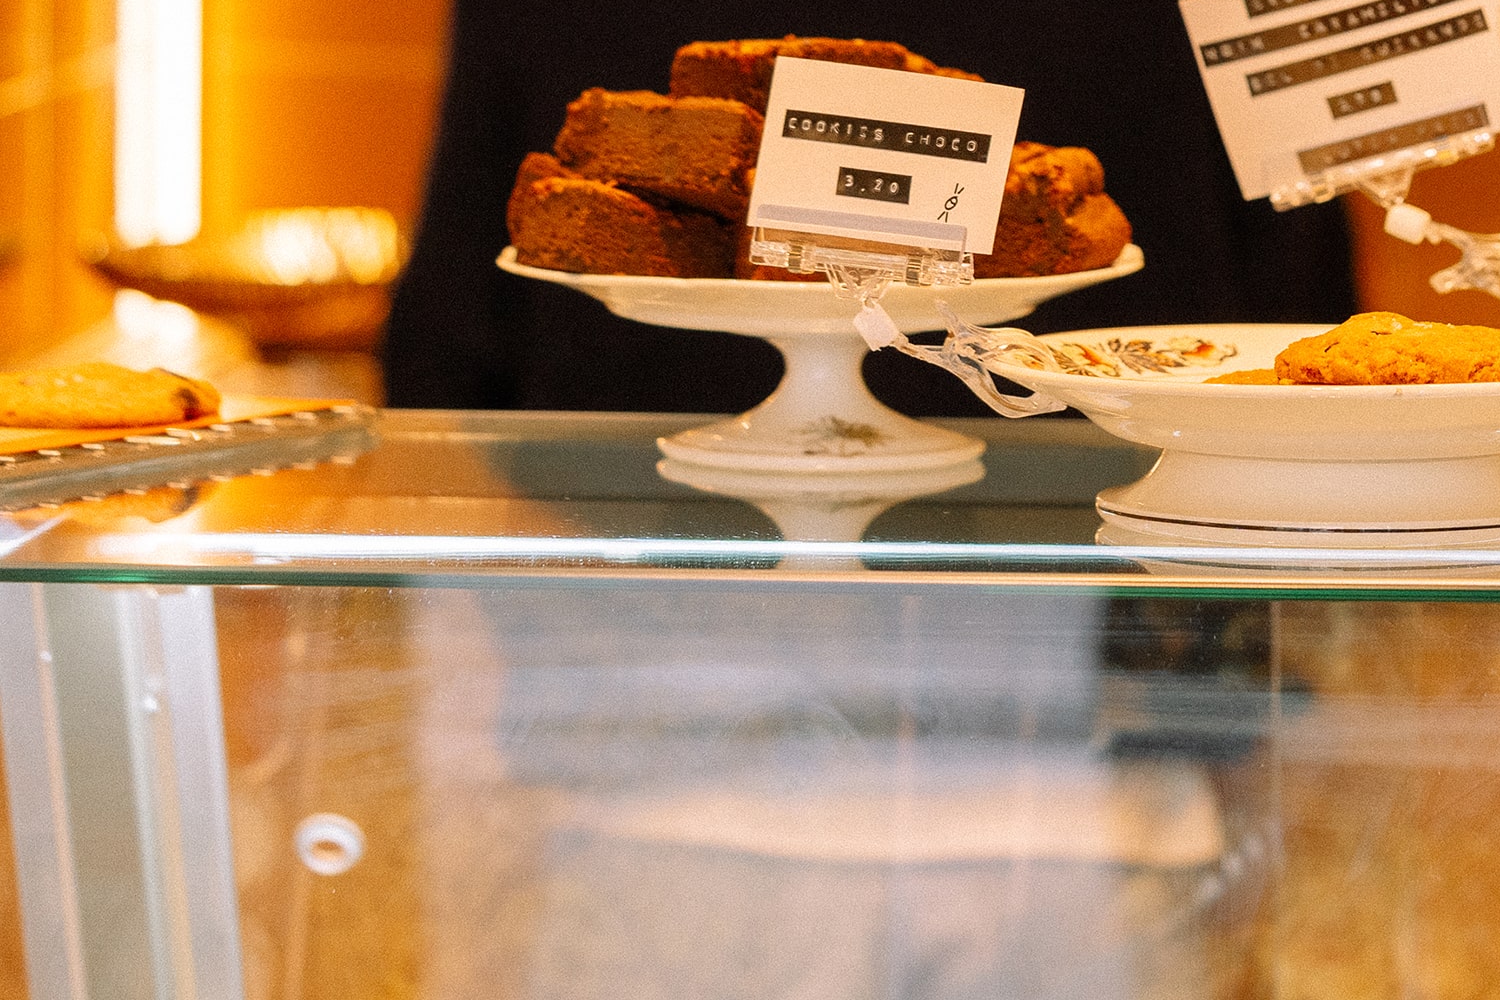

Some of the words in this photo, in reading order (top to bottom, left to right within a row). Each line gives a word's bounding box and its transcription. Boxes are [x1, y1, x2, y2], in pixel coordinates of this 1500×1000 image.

[787, 116, 885, 142] COOKIES
[905, 131, 977, 153] CHOCO
[845, 174, 898, 195] 3.20
